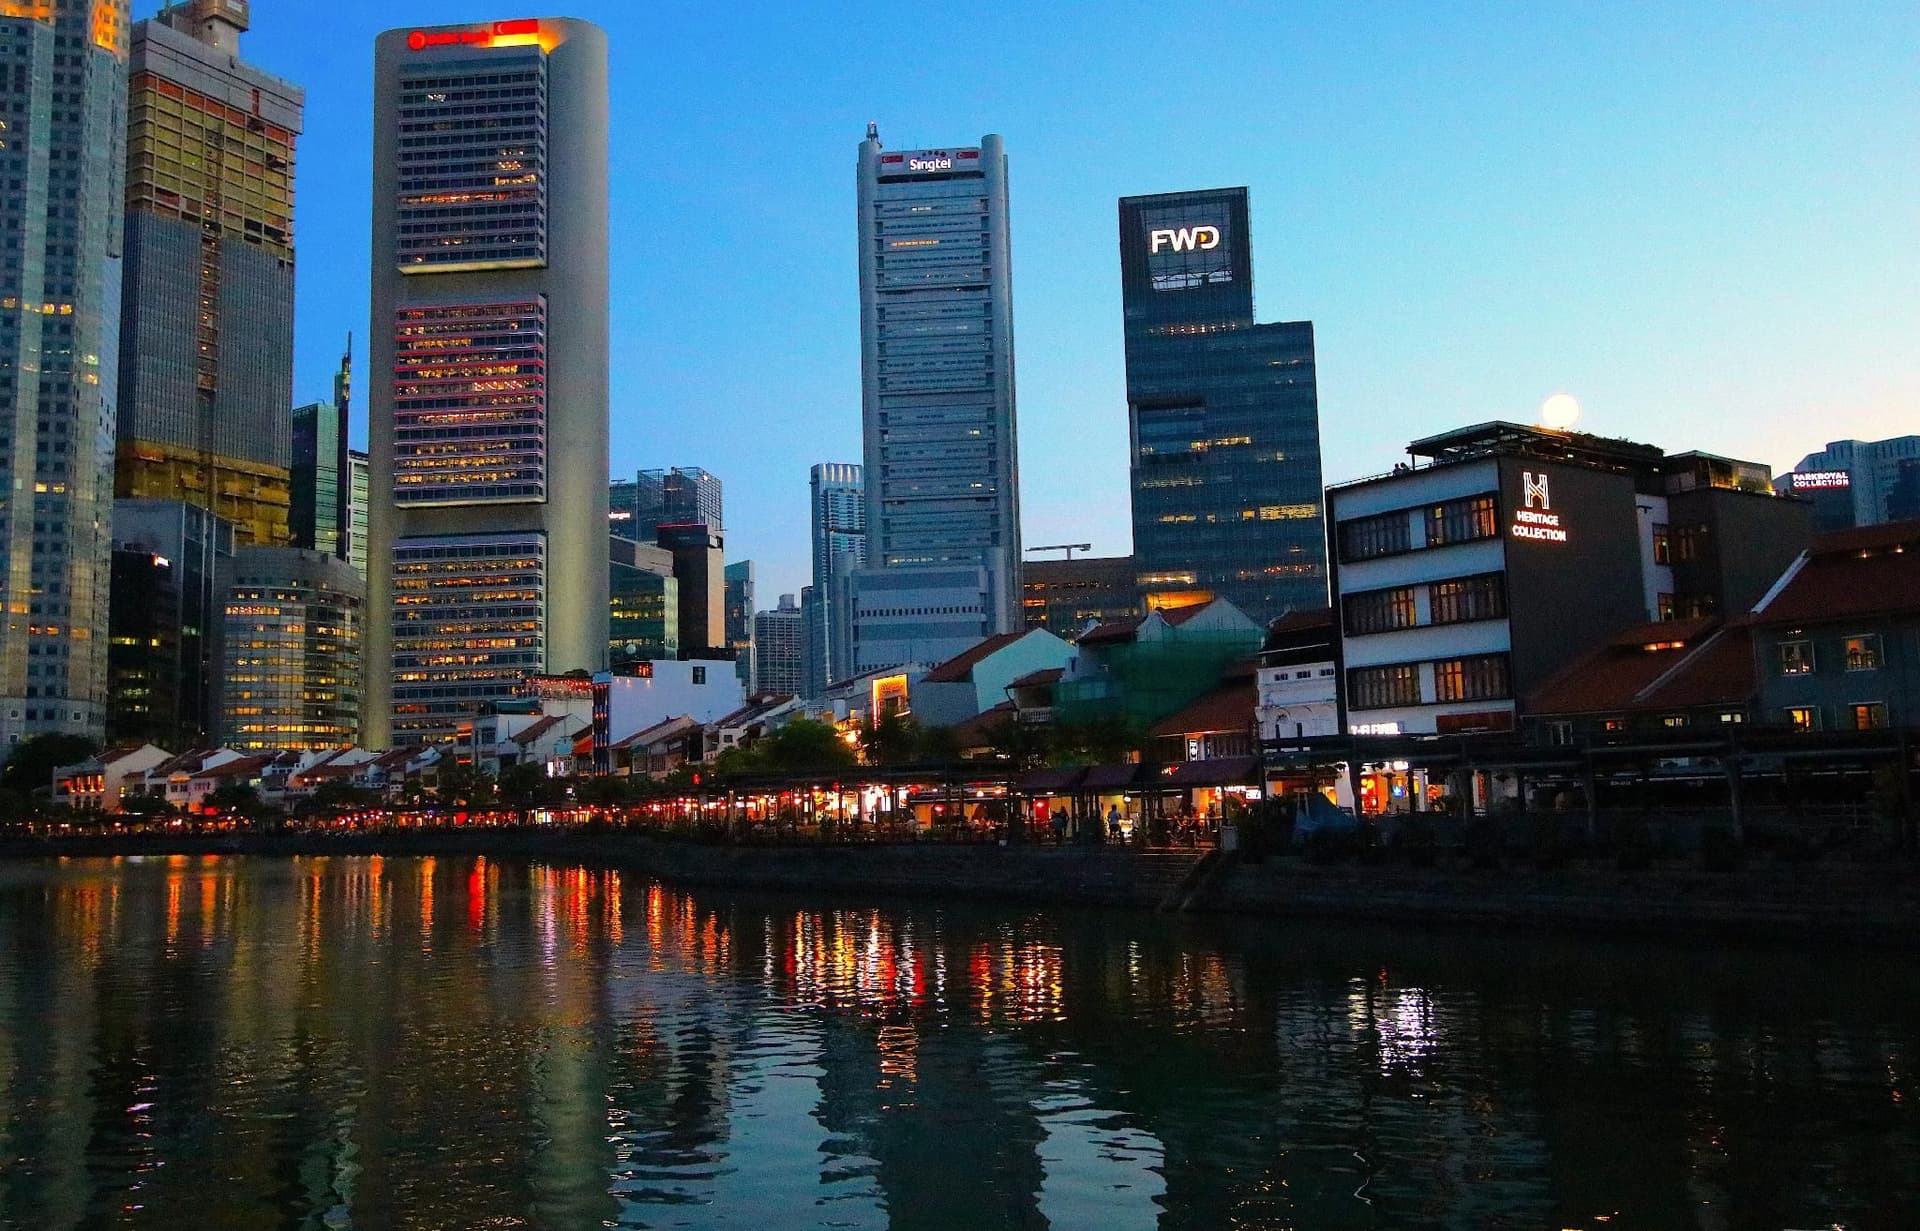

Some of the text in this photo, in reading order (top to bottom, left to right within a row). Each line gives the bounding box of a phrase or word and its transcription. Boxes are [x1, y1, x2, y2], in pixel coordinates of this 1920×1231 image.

[910, 158, 951, 172] Singtel
[1151, 226, 1220, 253] FWD
[1793, 472, 1848, 481] PARKROYAL
[1516, 511, 1559, 526] HERITAGE
[1512, 525, 1566, 541] COLLECTION
